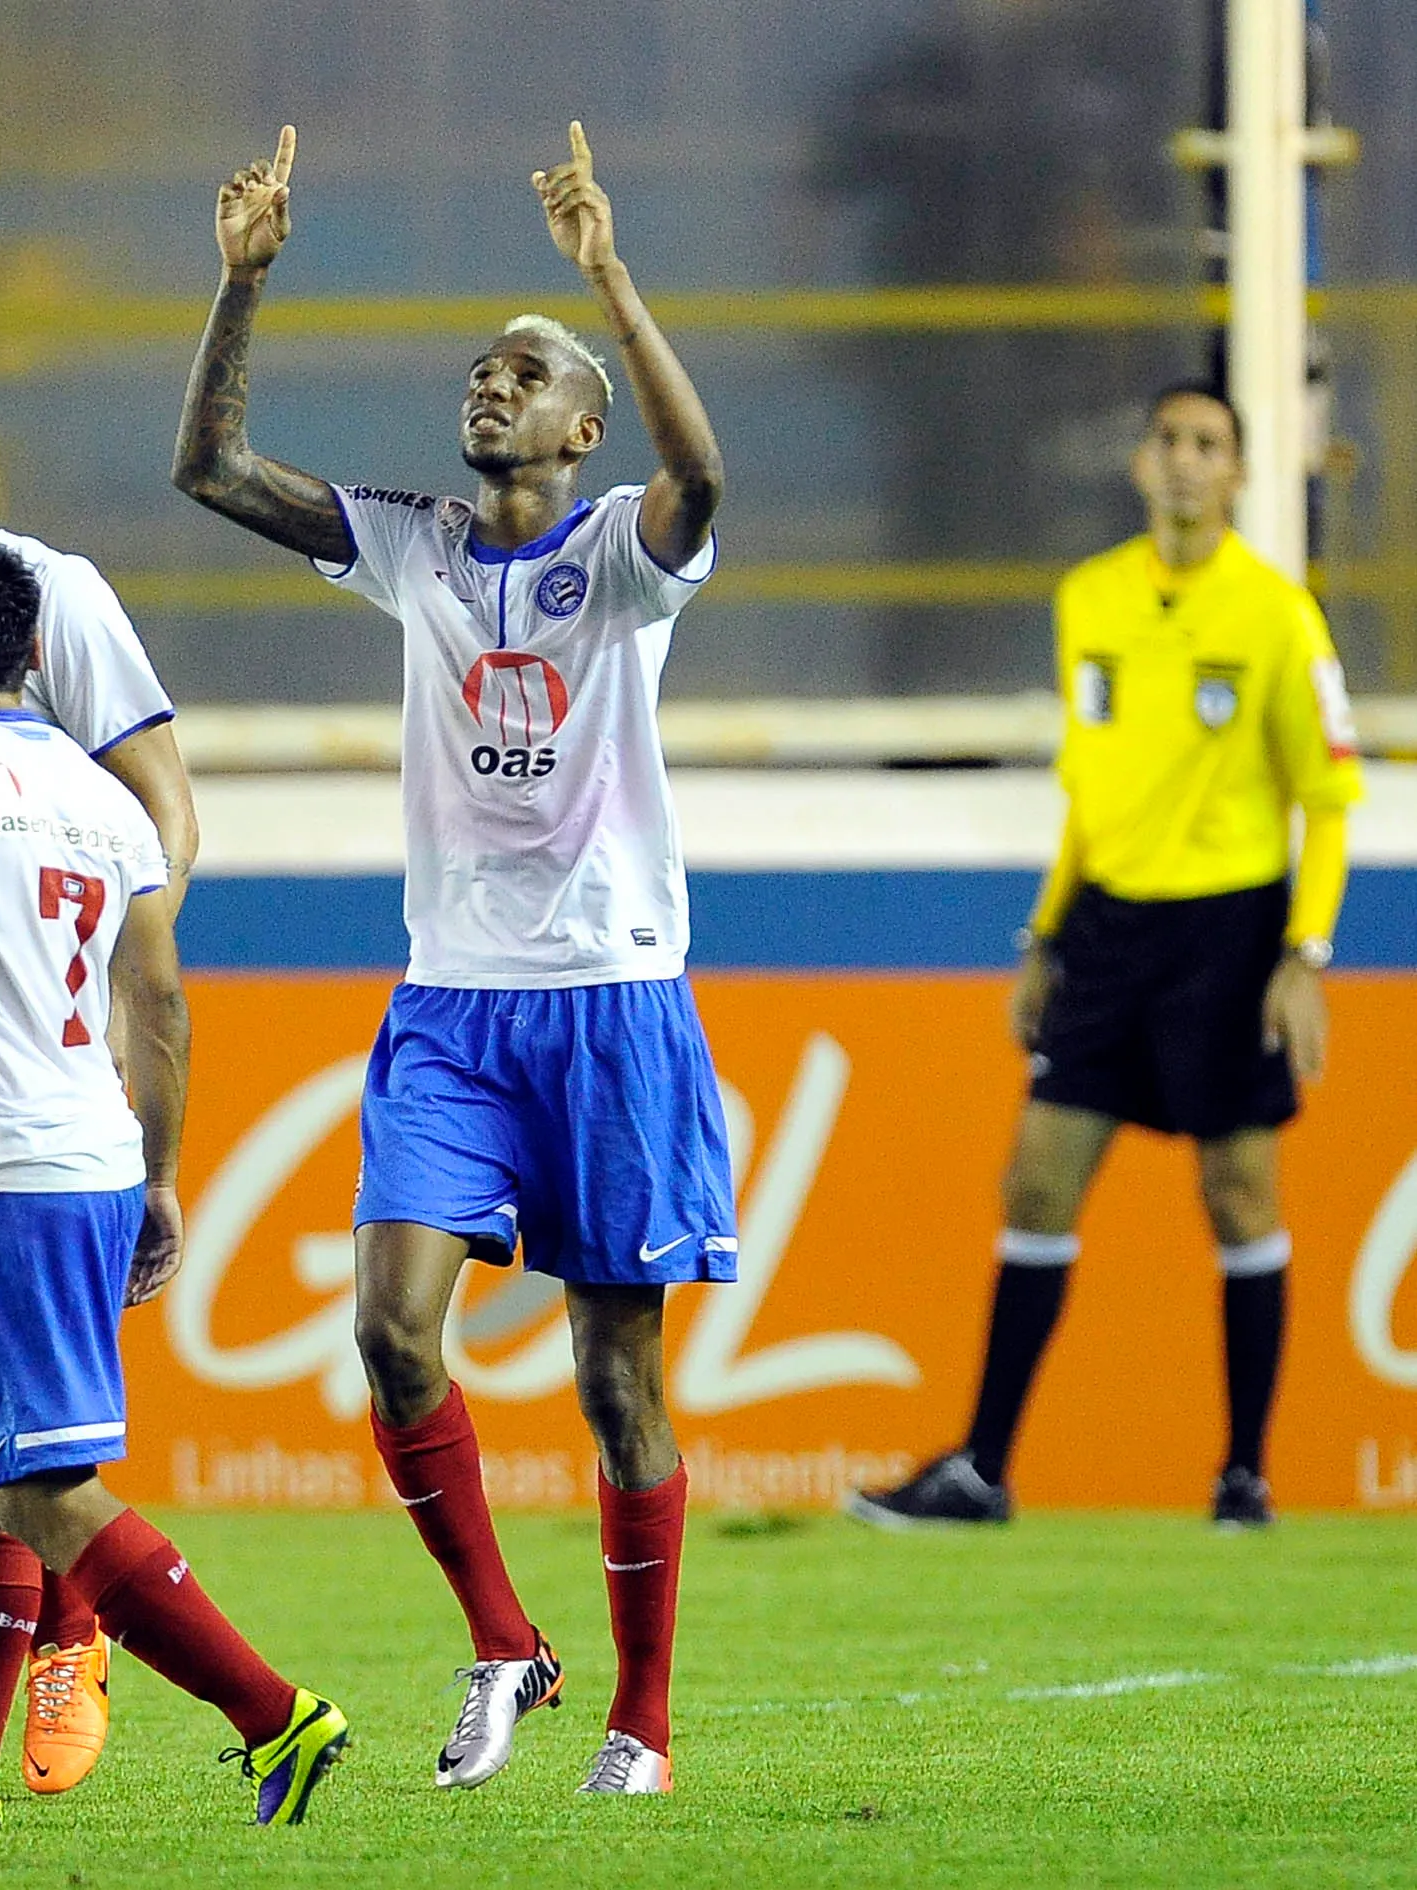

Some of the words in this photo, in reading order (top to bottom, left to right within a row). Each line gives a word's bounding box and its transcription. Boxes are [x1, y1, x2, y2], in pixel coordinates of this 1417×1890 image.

[470, 744, 557, 778] oas
[39, 866, 105, 1048] 7
[172, 1436, 365, 1503] Linhas
